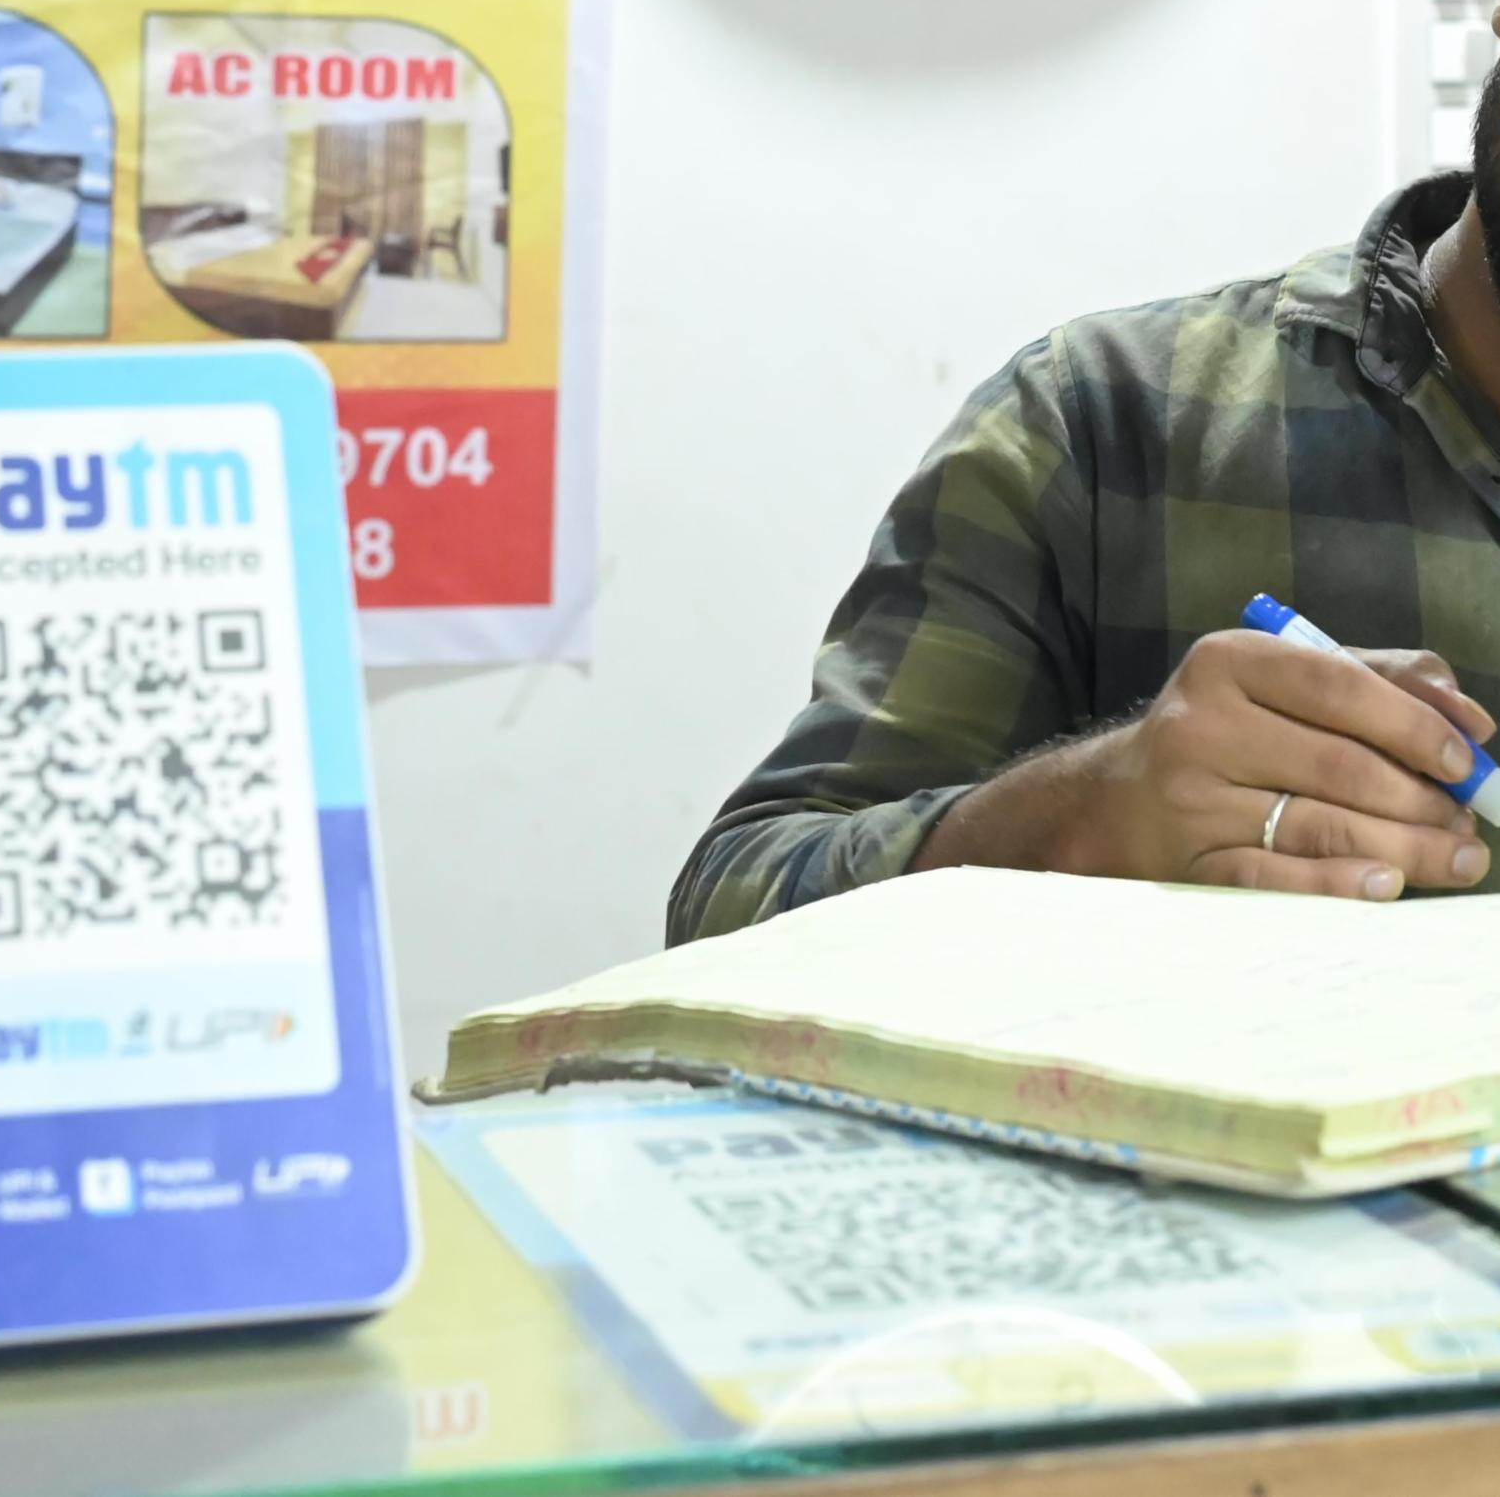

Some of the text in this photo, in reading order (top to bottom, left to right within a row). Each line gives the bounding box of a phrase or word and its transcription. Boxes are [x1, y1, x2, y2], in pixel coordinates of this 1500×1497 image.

[168, 52, 457, 101] AC ROOM
[161, 541, 262, 575] Here
